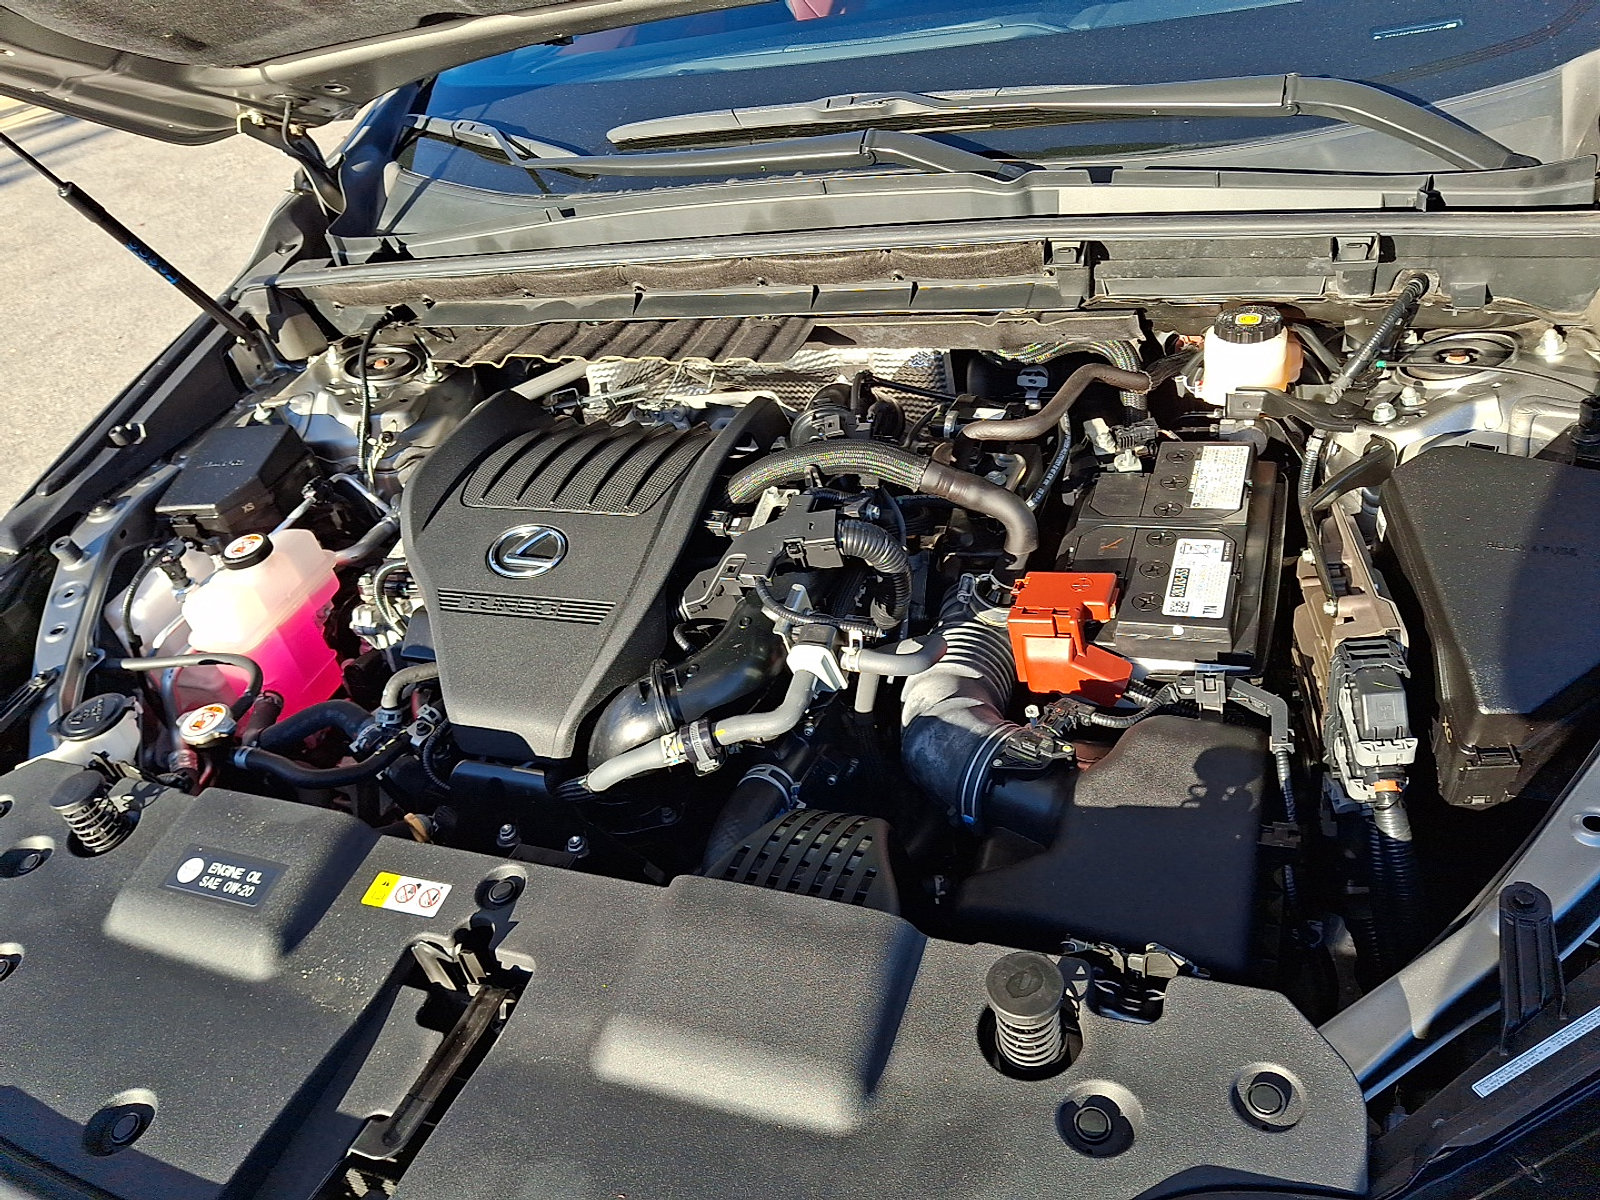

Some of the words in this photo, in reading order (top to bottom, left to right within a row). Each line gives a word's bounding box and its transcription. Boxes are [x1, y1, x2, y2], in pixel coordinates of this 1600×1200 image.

[207, 862, 246, 880] ENGINE
[246, 870, 262, 885] OIL
[199, 875, 222, 890] SAE
[222, 881, 256, 898] 0W-20
